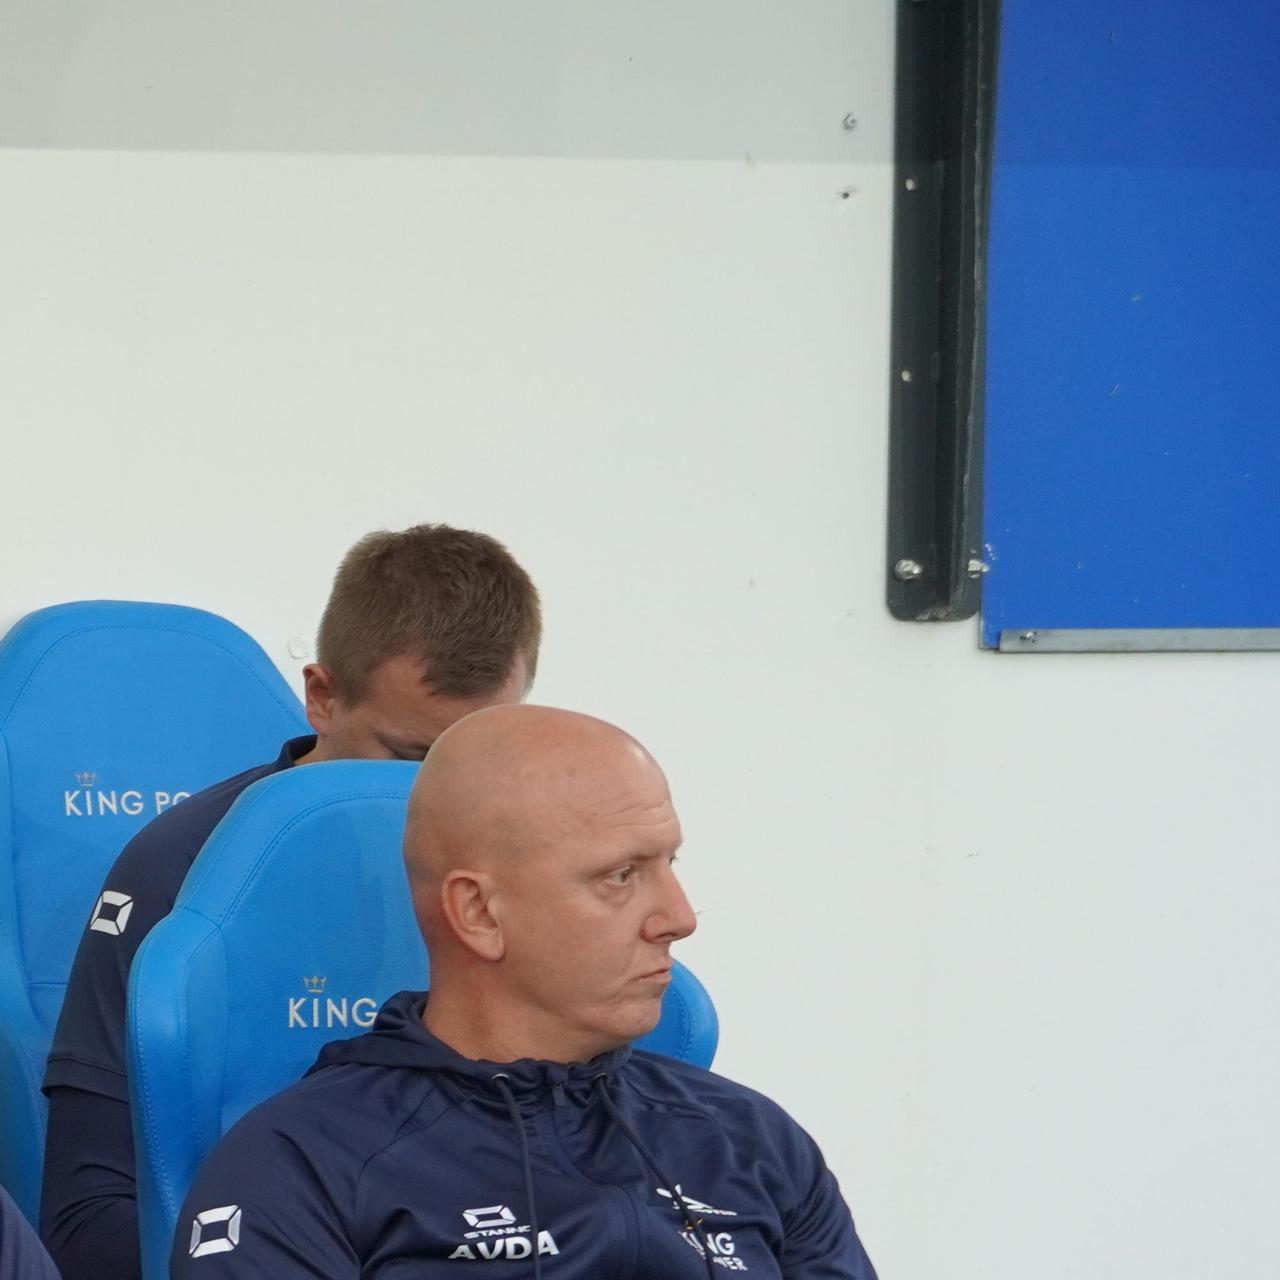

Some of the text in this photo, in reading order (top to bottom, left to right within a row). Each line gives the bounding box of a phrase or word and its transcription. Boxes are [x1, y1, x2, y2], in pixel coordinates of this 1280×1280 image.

[64, 790, 144, 816] KING
[288, 997, 378, 1028] KING
[447, 1230, 560, 1260] AVDA
